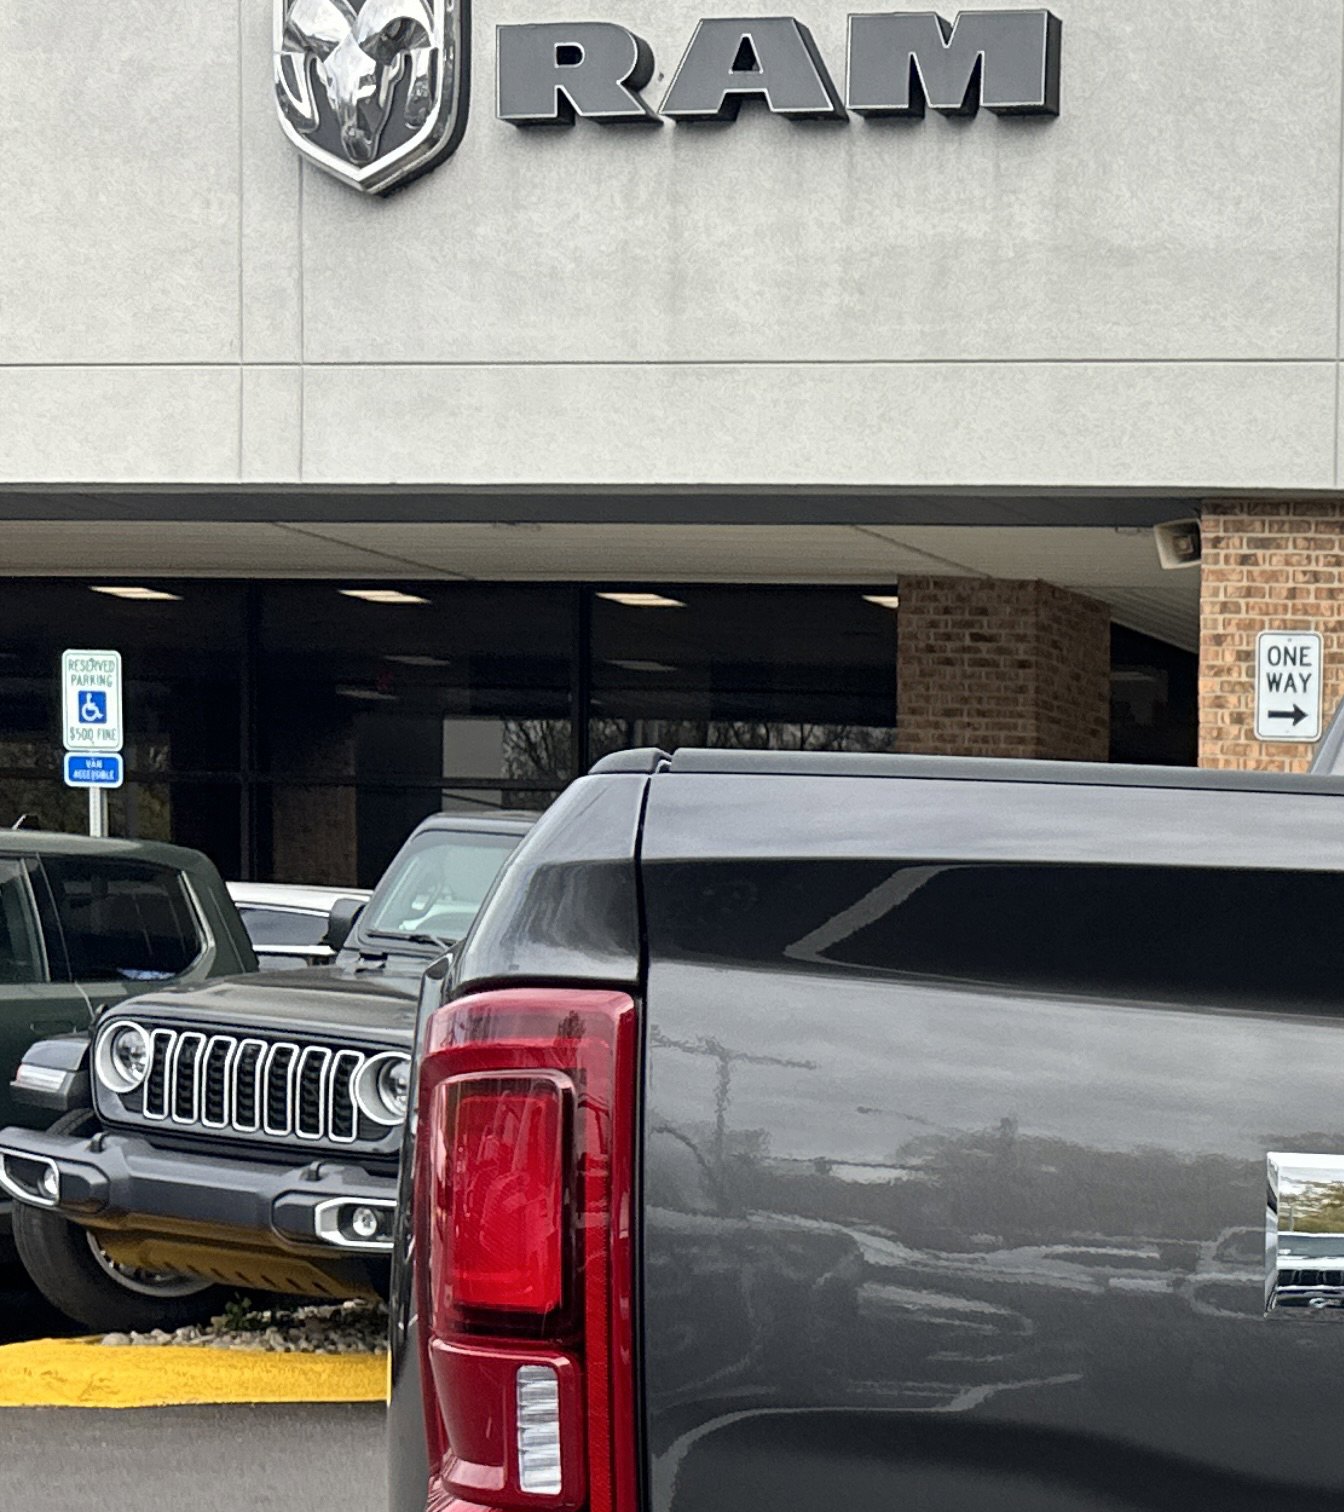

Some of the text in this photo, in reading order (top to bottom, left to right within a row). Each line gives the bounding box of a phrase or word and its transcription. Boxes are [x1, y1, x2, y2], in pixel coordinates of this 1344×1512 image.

[496, 9, 1063, 130] RAM
[1267, 645, 1313, 667] ONE
[68, 658, 116, 673] RESERVED
[70, 674, 113, 688] PARKING
[1266, 672, 1312, 694] WAY
[69, 727, 117, 742] $500 FINE
[85, 759, 103, 769] VAN
